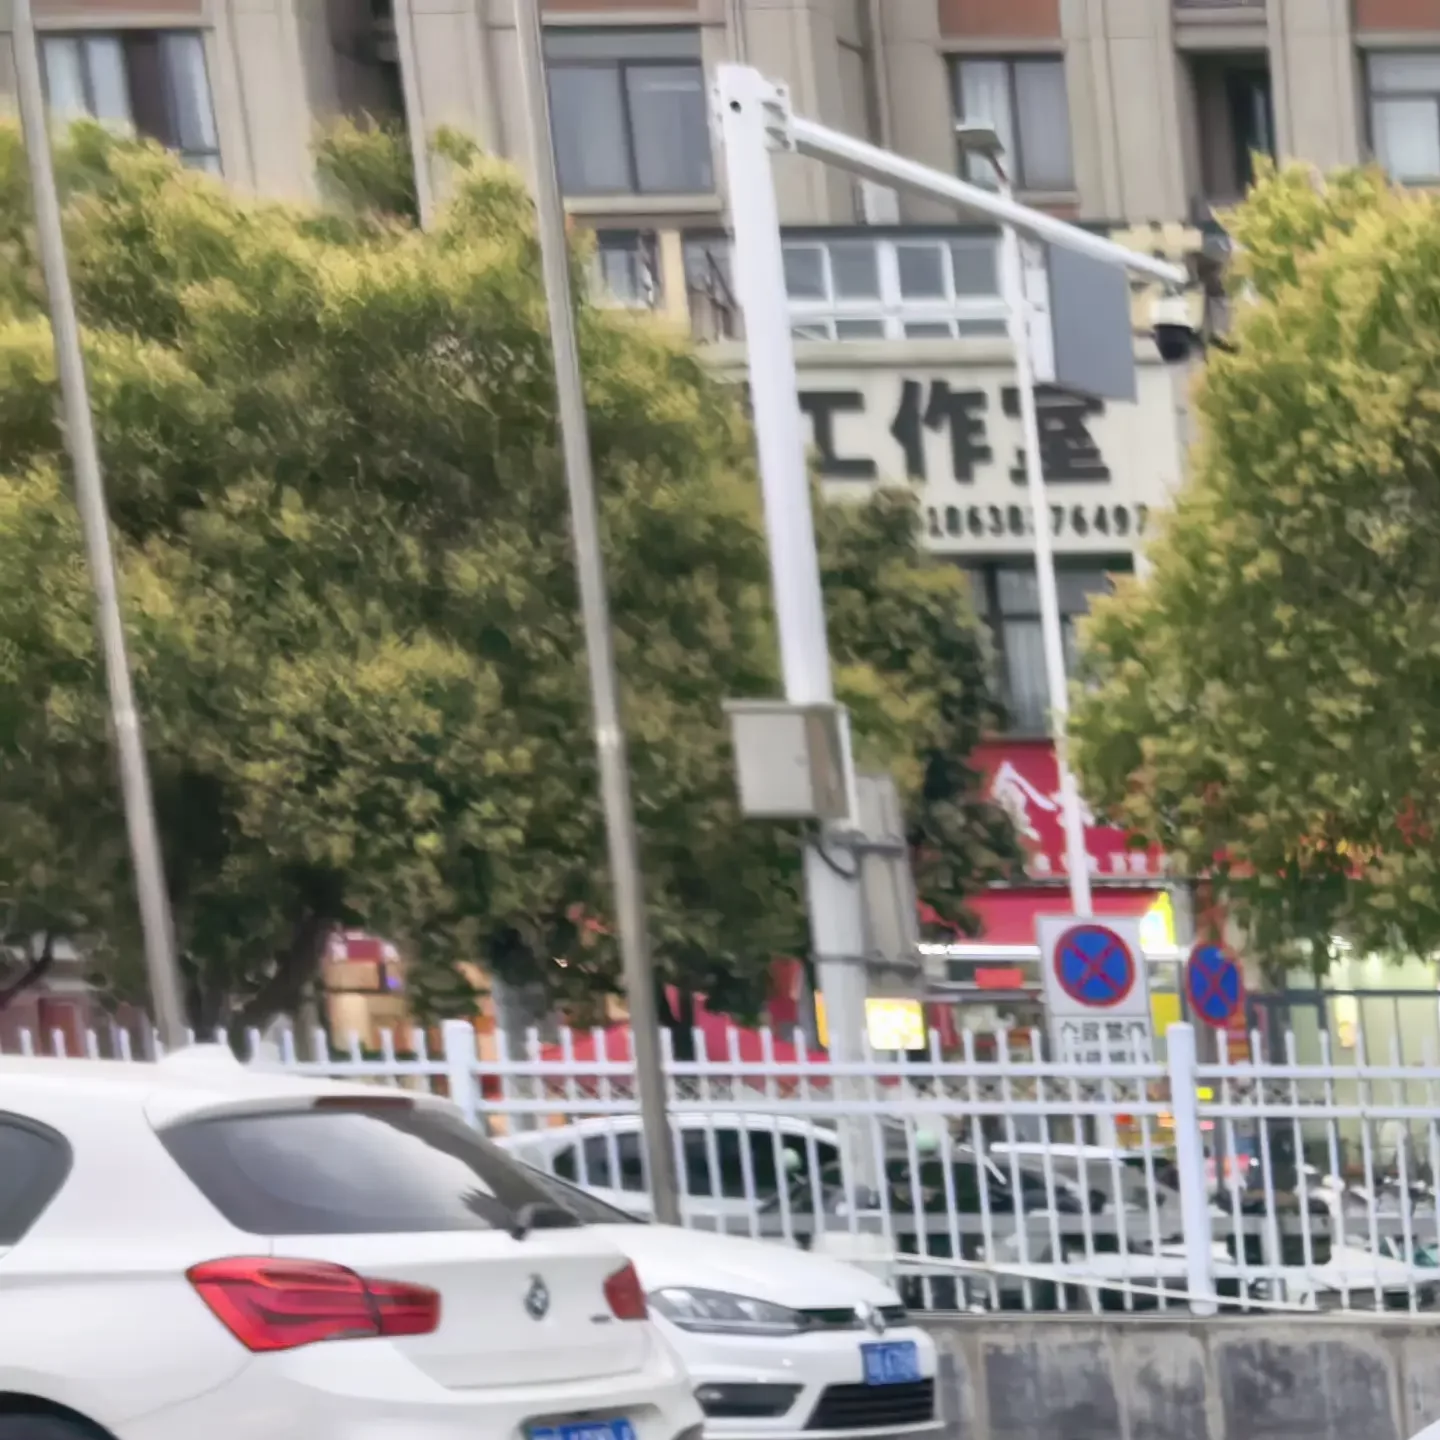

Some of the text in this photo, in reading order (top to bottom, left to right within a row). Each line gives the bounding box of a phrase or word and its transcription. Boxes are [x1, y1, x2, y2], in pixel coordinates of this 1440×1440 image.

[798, 379, 1111, 485] 工作室
[927, 504, 1149, 538] 1863876497
